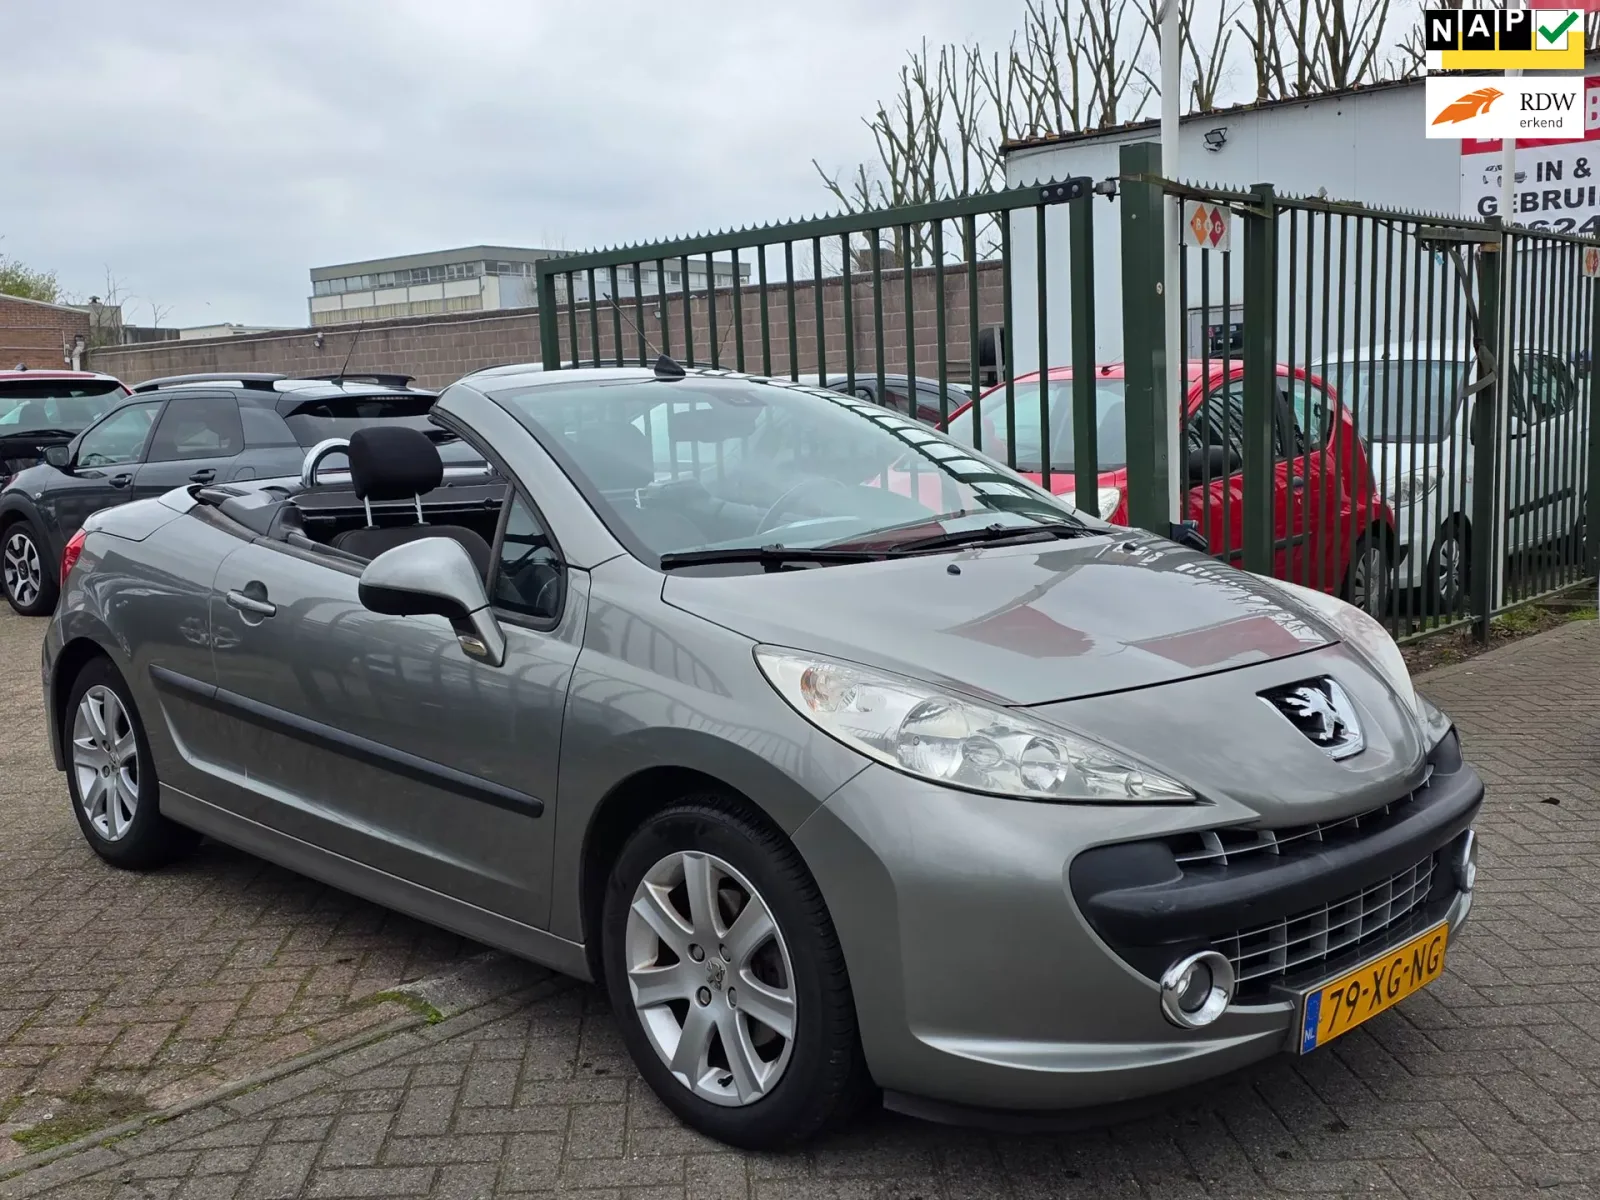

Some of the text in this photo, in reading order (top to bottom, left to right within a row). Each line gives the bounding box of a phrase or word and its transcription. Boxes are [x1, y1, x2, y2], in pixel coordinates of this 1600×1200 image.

[1536, 157, 1592, 182] IN &
[1328, 935, 1441, 1034] 79-XG-NG
[1304, 1028, 1315, 1042] NL
